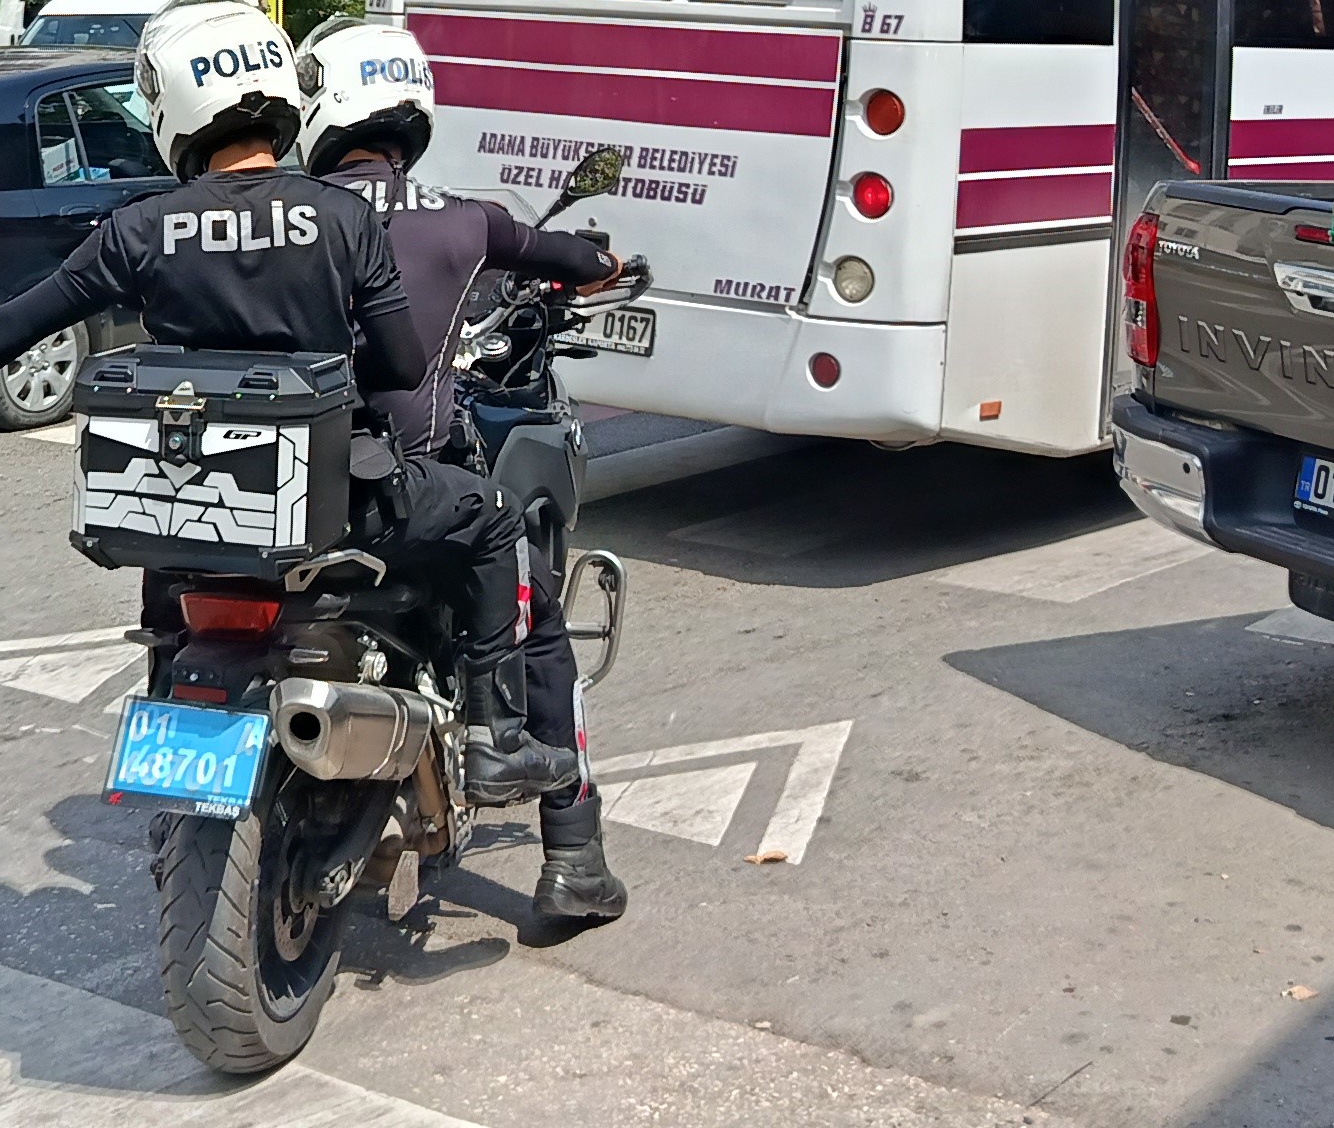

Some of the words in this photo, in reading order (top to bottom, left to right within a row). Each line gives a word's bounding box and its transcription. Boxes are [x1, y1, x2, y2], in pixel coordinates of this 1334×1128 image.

[880, 14, 905, 35] 67
[477, 132, 526, 157] ADANA
[636, 146, 739, 179] BELEDİYESİ
[499, 163, 544, 189] ÖZEL
[163, 199, 319, 255] POLİS
[1157, 240, 1201, 260] TOYOTA
[713, 279, 796, 303] MURAT
[603, 312, 651, 344] 0167
[223, 429, 262, 440] GP
[128, 710, 171, 745] 01
